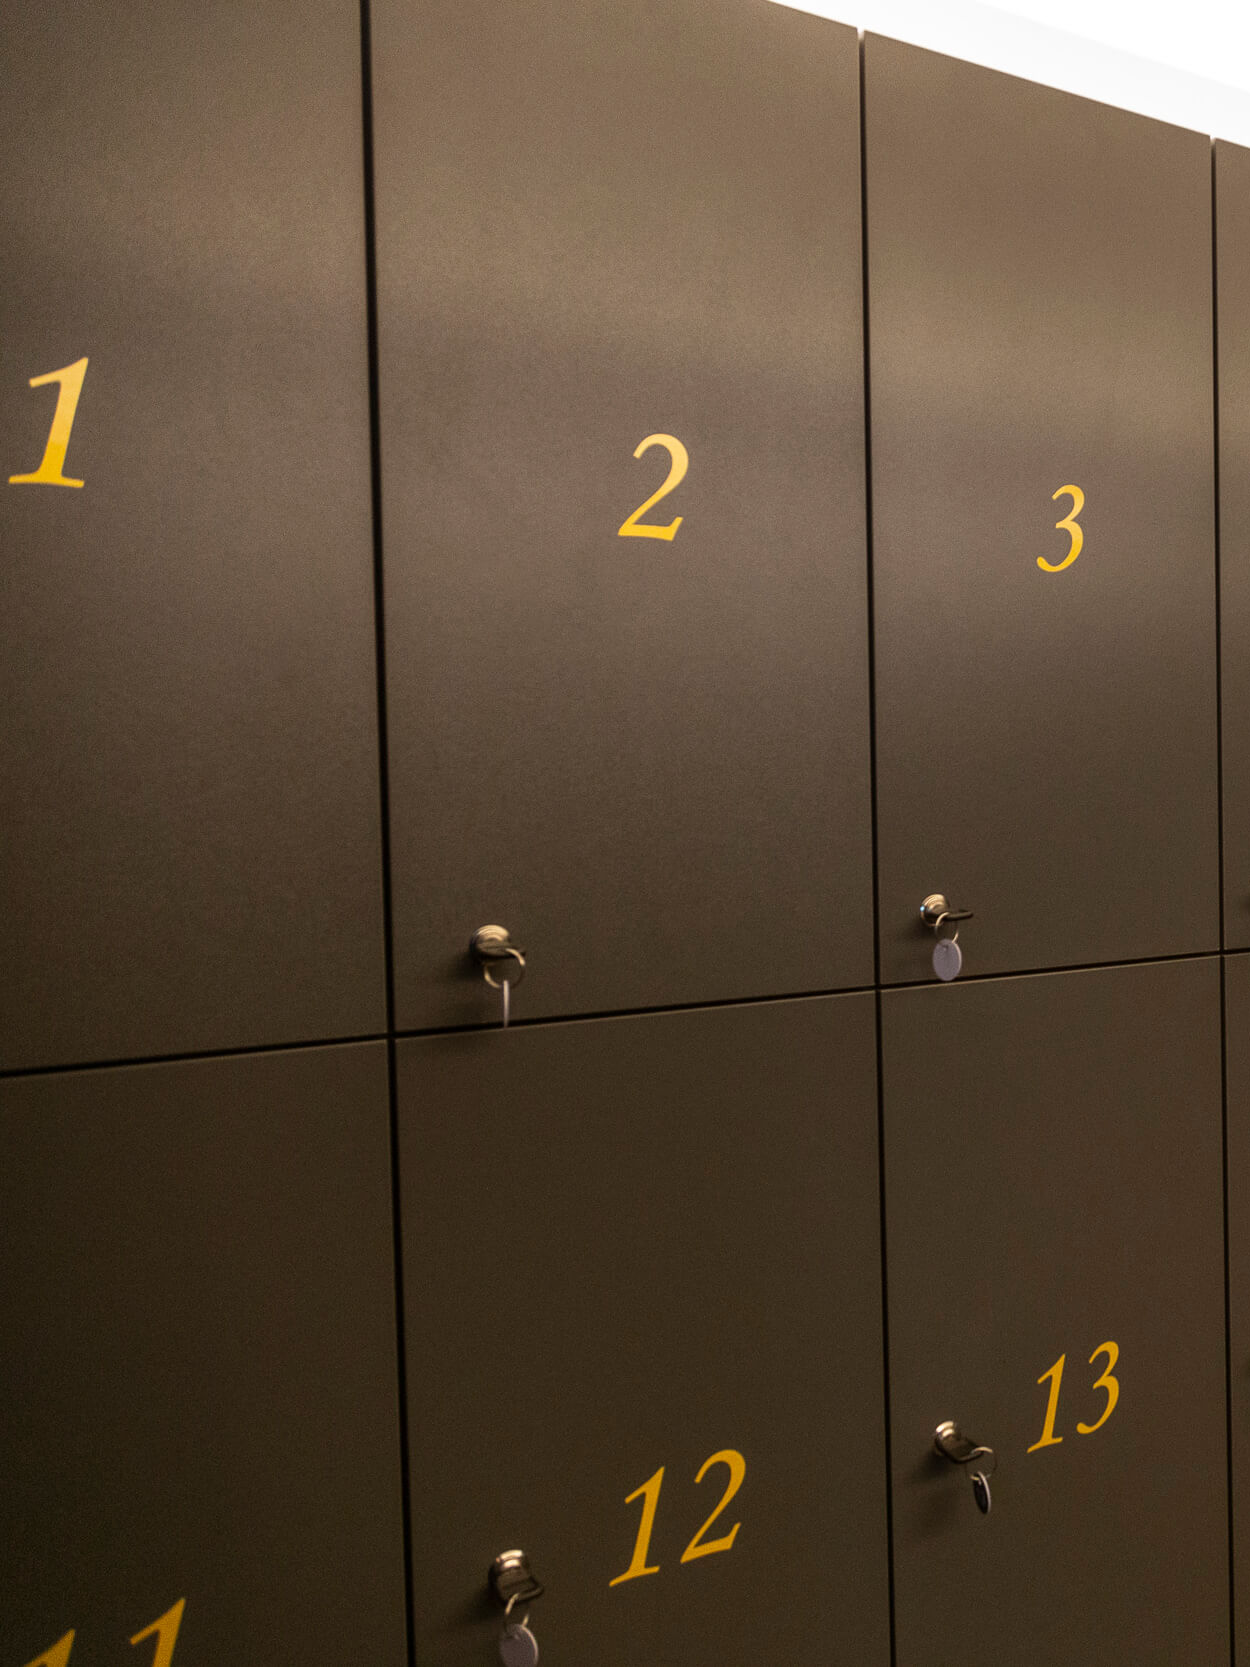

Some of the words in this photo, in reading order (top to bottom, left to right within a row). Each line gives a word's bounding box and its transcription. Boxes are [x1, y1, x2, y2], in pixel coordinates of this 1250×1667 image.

[8, 357, 89, 489] 1
[617, 433, 689, 542] 2
[1035, 484, 1086, 574] 3
[1027, 1339, 1121, 1454] 13
[608, 1448, 747, 1588] 12
